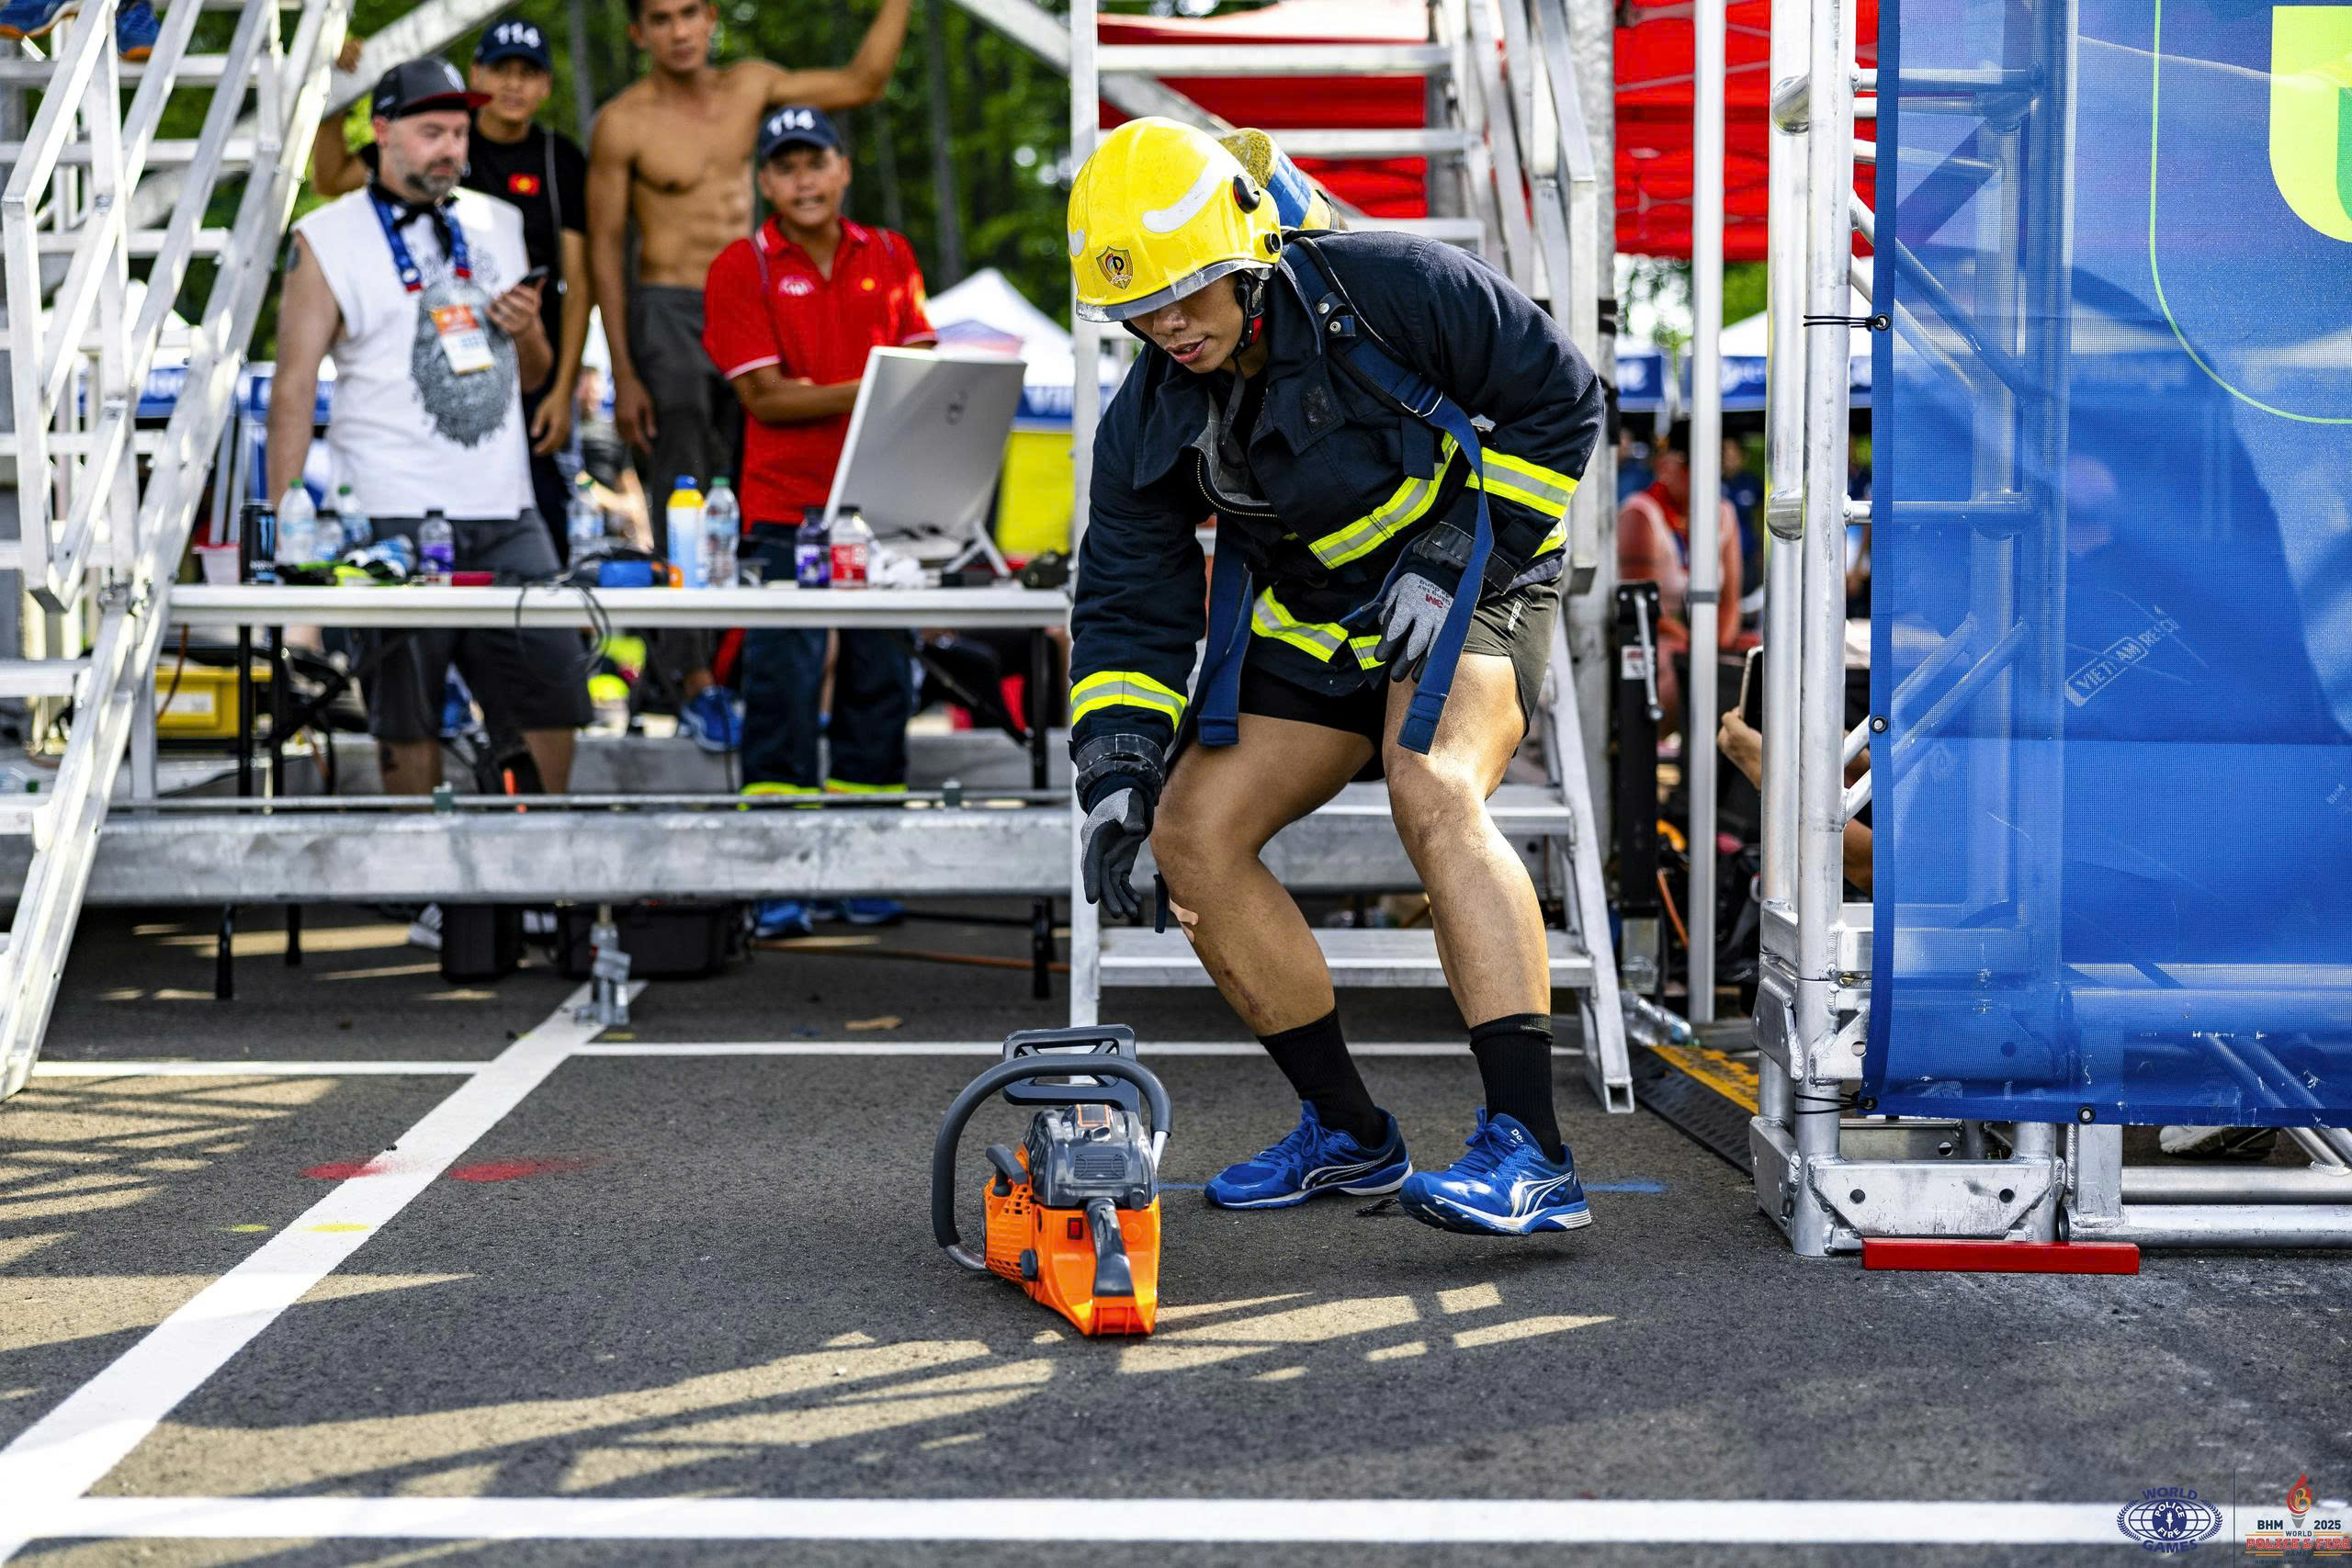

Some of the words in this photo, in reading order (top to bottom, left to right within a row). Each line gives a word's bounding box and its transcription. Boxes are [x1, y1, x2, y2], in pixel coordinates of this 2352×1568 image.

[493, 22, 541, 49] 114
[767, 109, 816, 136] 114
[1426, 592, 1443, 608] 3M
